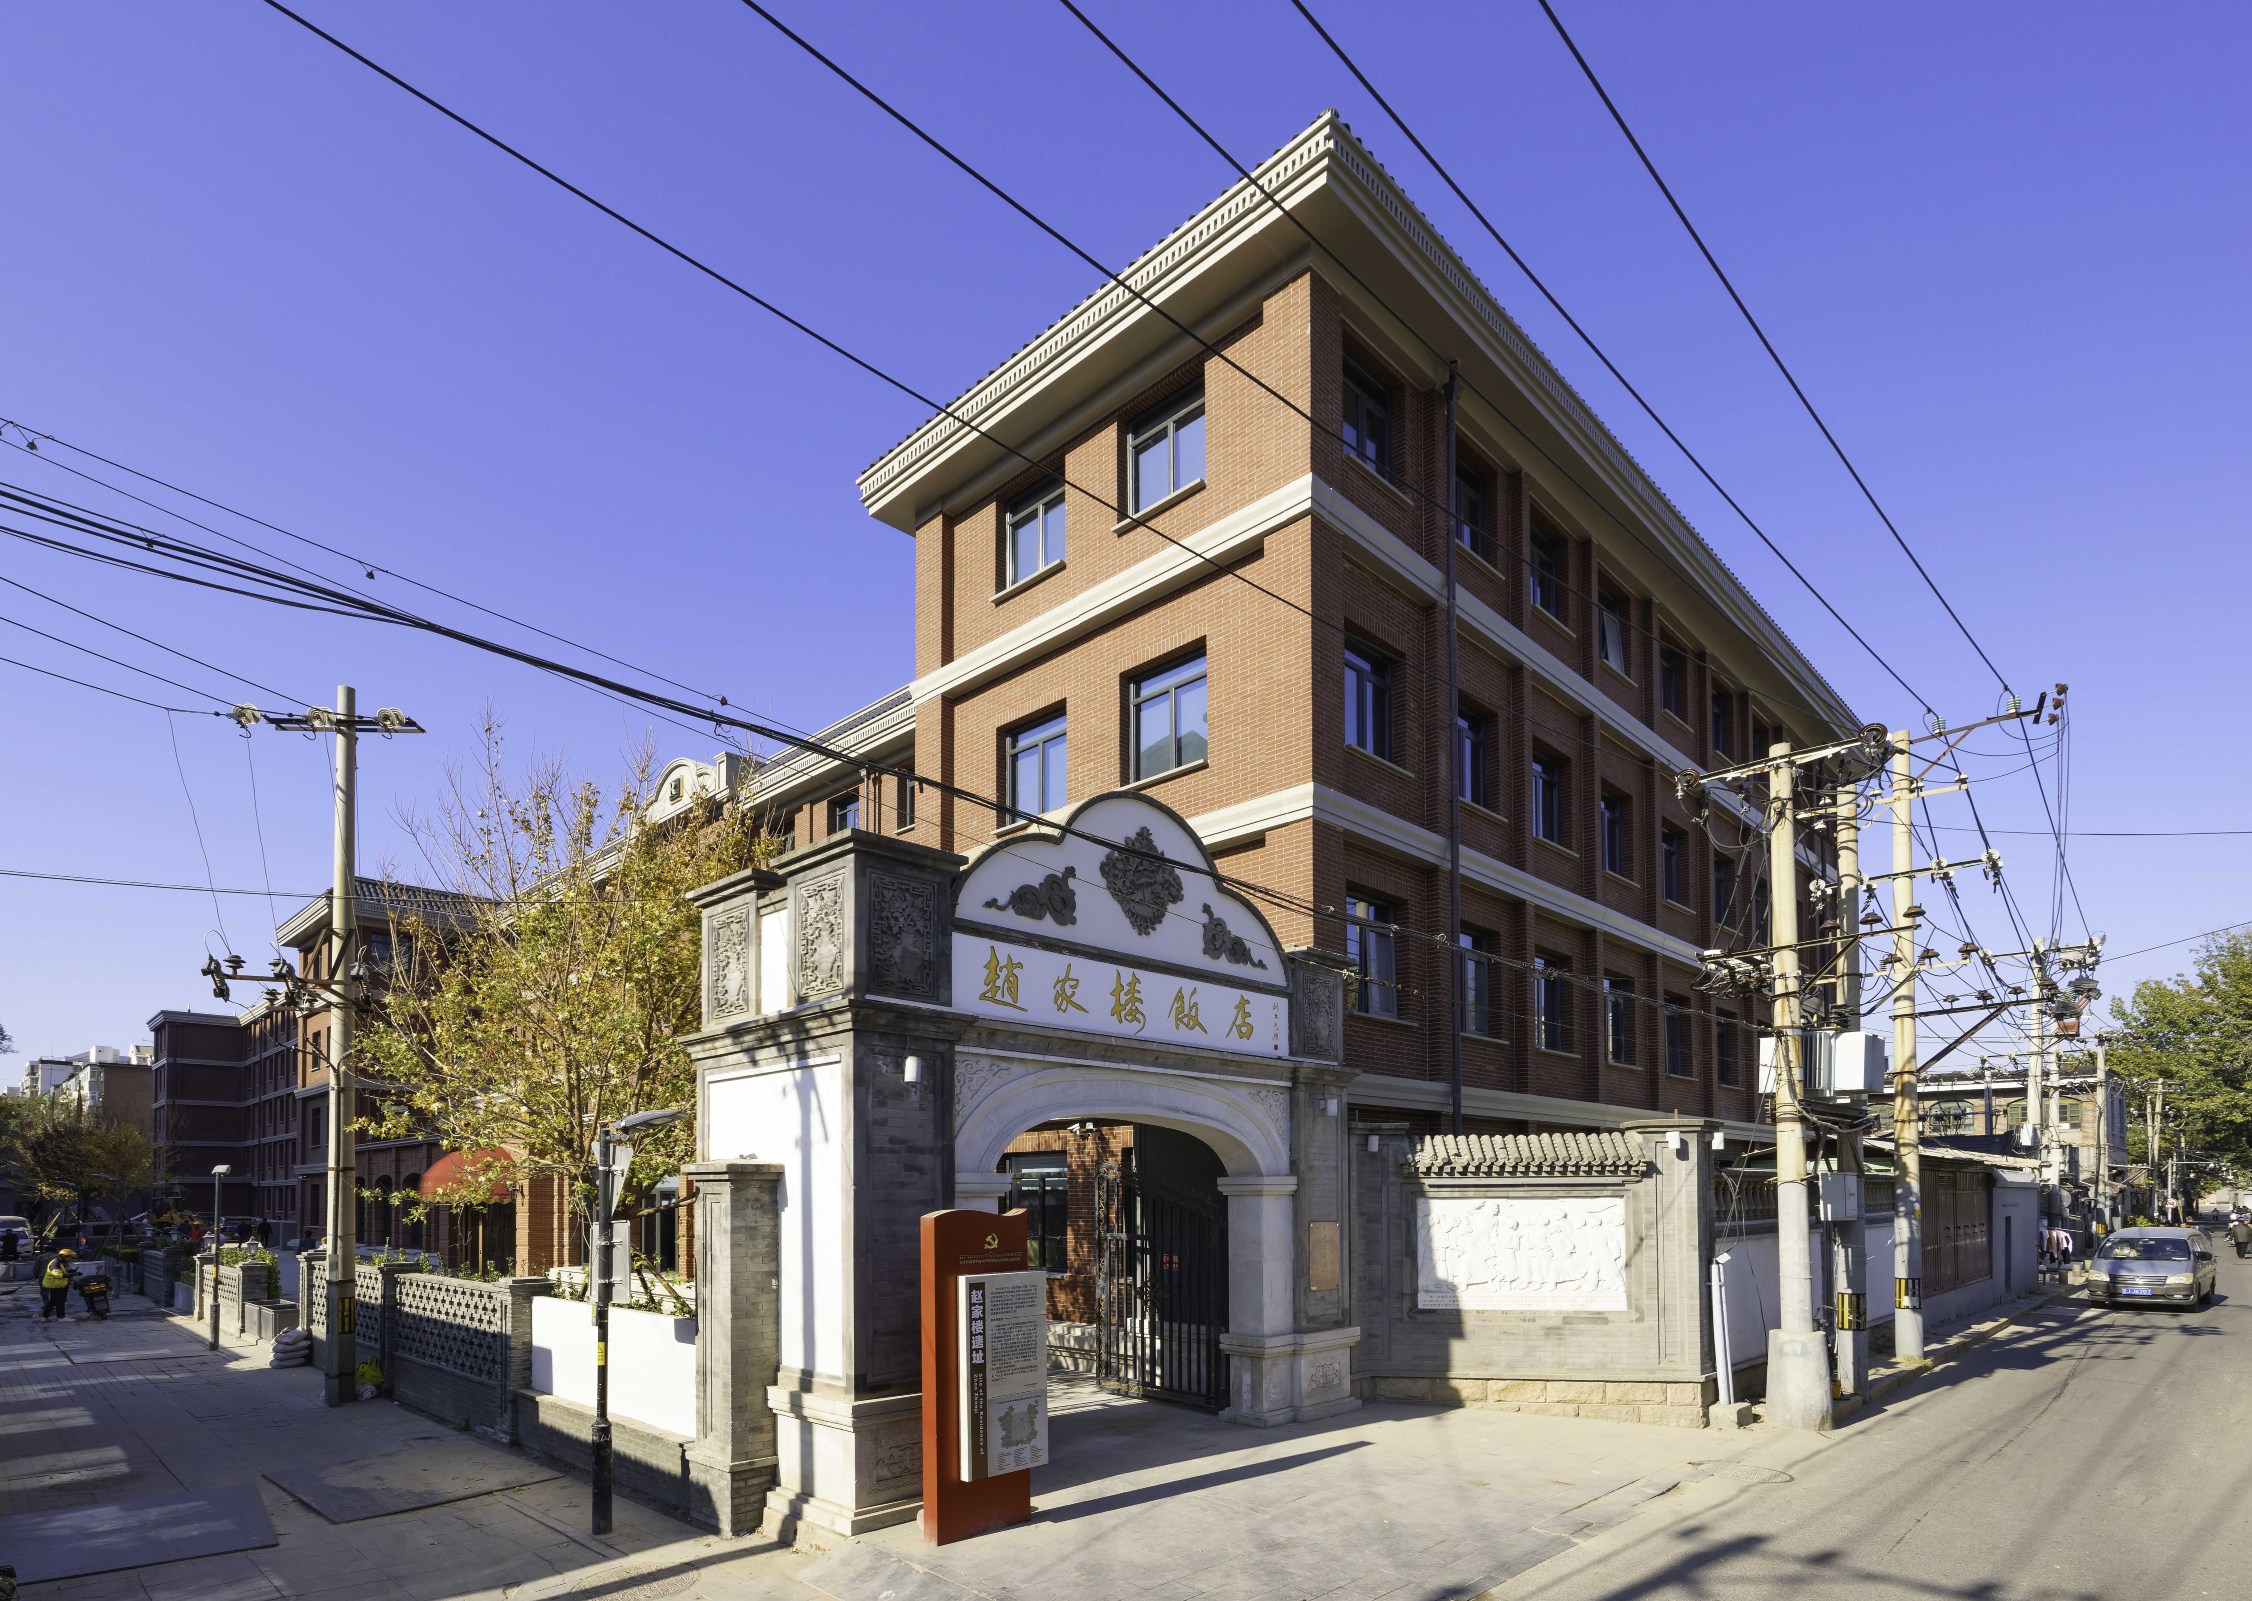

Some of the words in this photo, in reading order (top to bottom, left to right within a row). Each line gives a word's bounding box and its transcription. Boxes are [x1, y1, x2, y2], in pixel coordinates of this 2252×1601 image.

[971, 1289, 985, 1364] 赵家楼遗址
